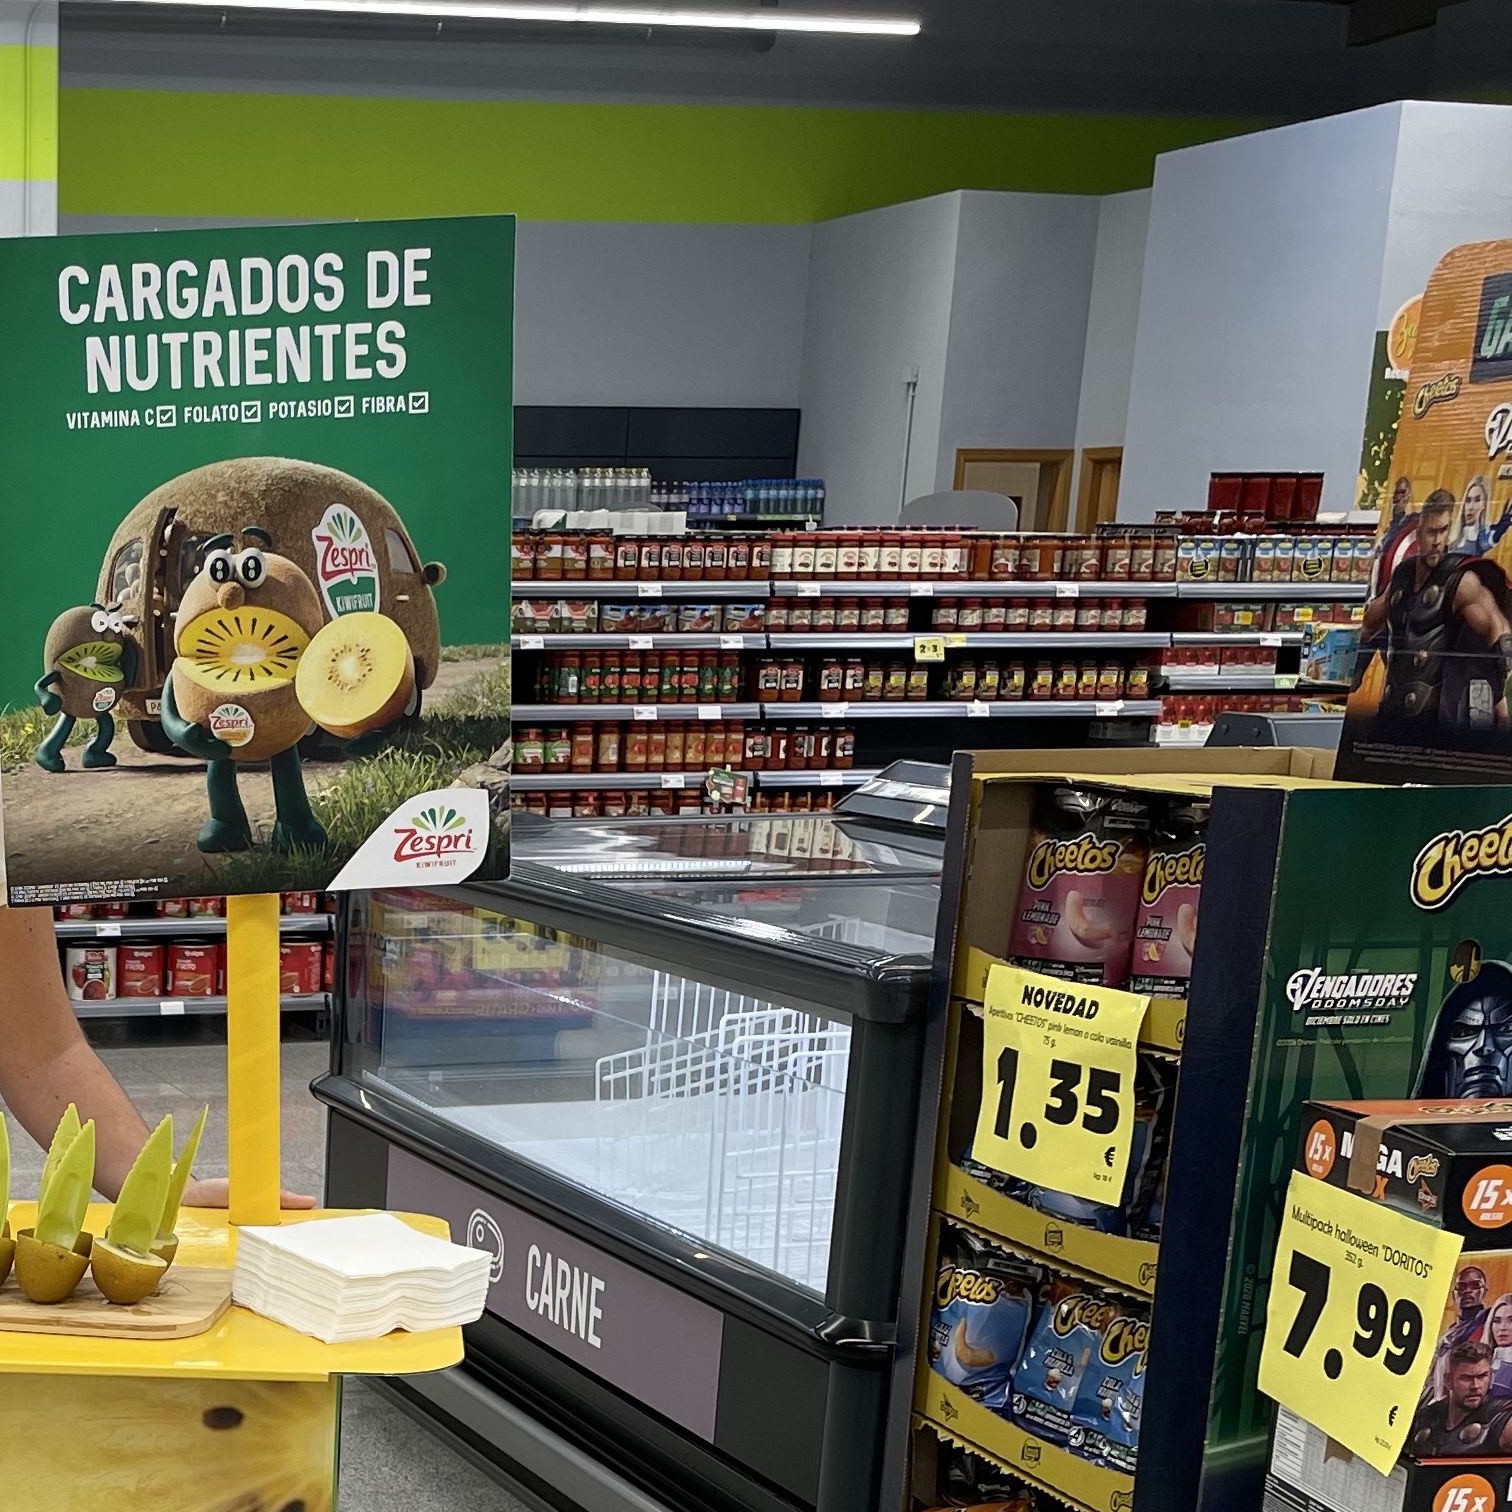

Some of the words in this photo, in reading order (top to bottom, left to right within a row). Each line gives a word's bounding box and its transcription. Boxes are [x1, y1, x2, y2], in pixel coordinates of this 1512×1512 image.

[57, 252, 345, 325] CARGADOS
[366, 247, 432, 309] DE
[85, 320, 408, 394] NUTRIENTES
[66, 409, 141, 430] VITAMINA
[144, 408, 155, 427] C
[183, 405, 239, 424] FOLATO
[268, 399, 332, 420] POTASIO
[361, 395, 407, 415] FIBRA
[316, 535, 374, 582] Zespri
[336, 593, 374, 613] KIWIFRUIT
[210, 716, 250, 730] Zespri
[393, 828, 475, 863] Zespri
[1028, 834, 1121, 890] Cheetos
[1021, 911, 1060, 926] LEMONADE
[1032, 900, 1052, 912] PINK
[1021, 984, 1100, 1019] NOVEDAD
[1286, 967, 1418, 1011] VENGADORES
[1311, 997, 1410, 1009] DOOMSDAY
[993, 1046, 1121, 1150] 1.35
[1103, 1146, 1116, 1167] €
[1291, 1205, 1333, 1236] Multipack
[1334, 1224, 1379, 1257] halloween
[1382, 1244, 1433, 1278] "DORITOS"
[525, 1244, 605, 1349] CARNE
[1053, 1294, 1113, 1338] Chee
[1238, 1301, 1251, 1335] MARVEL
[1282, 1249, 1423, 1380] 7.99
[1387, 1406, 1399, 1426] €
